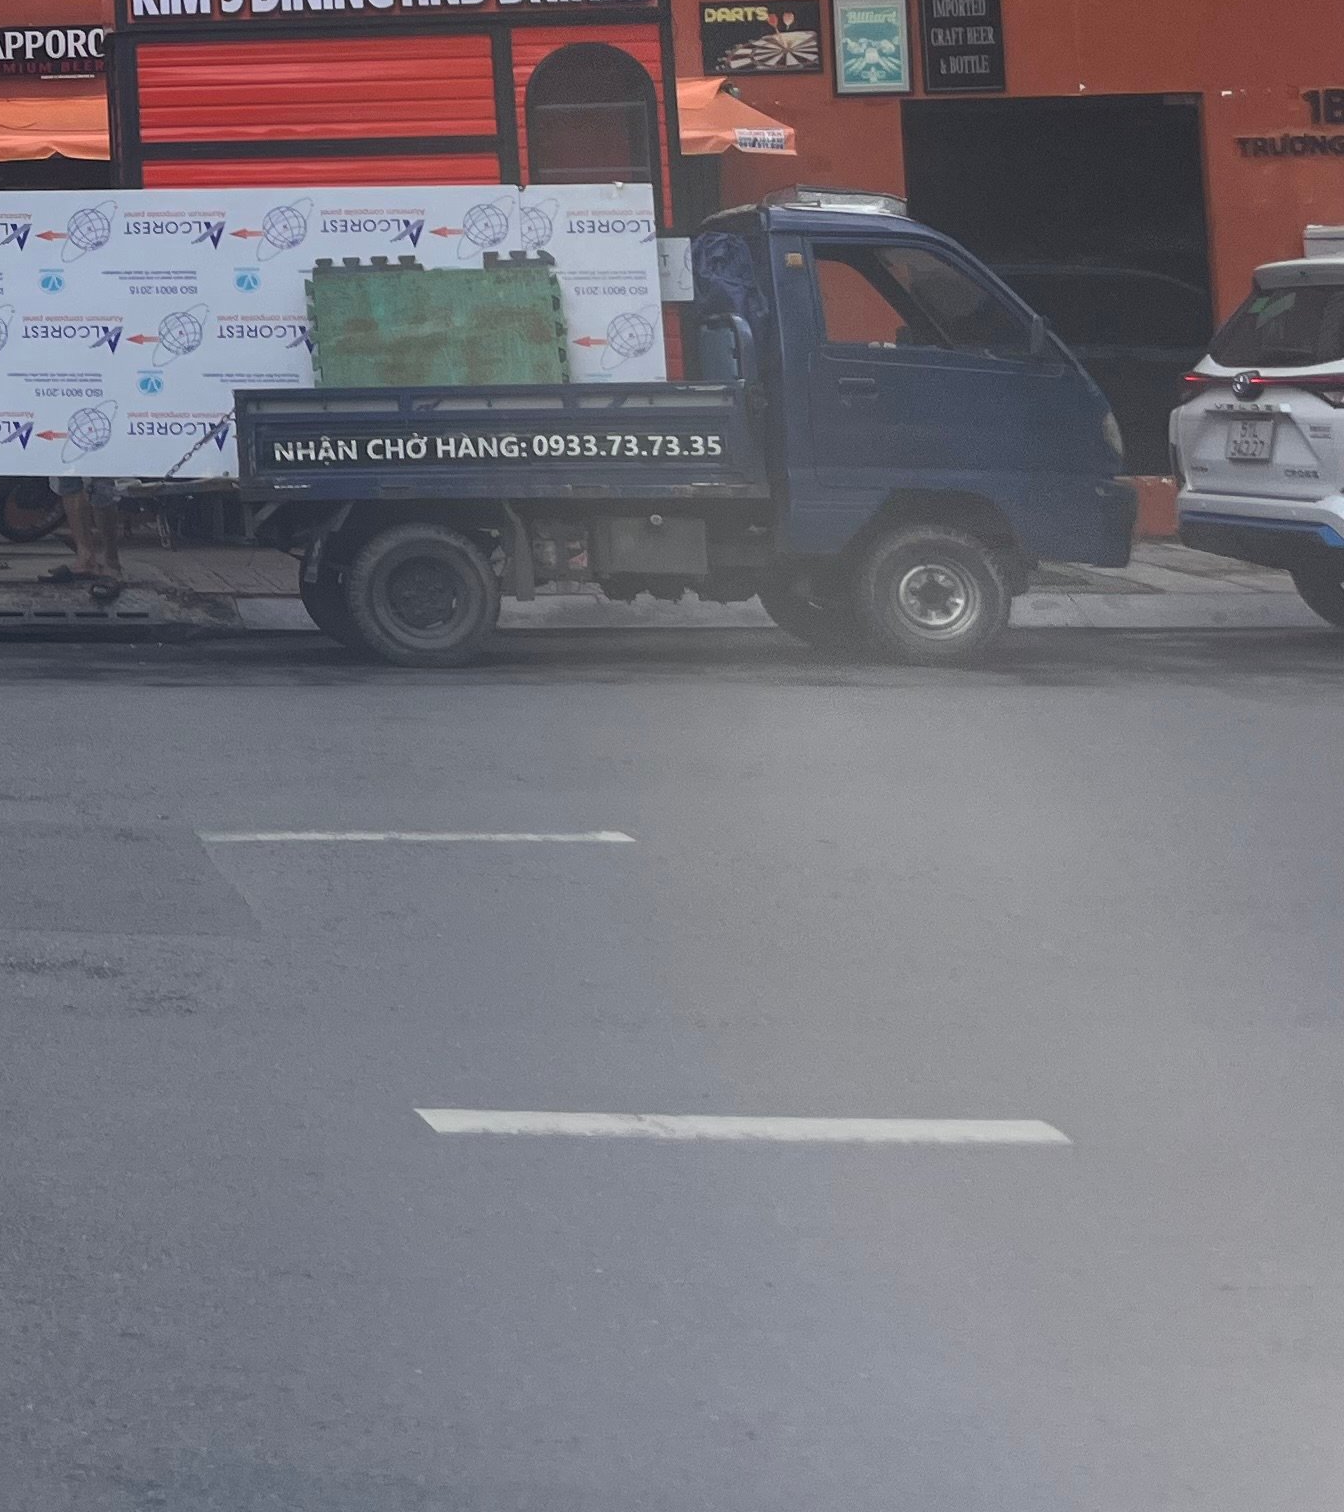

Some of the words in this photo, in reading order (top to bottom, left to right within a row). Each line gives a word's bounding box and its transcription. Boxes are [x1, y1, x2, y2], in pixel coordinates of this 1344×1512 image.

[704, 7, 768, 23] DARTS
[931, 27, 964, 46] CRAFT
[966, 26, 996, 44] BEER
[62, 61, 105, 72] BEER
[949, 55, 990, 74] BOTTLE
[124, 221, 226, 250] ALCOREST
[321, 219, 425, 248] ALCOREST
[566, 220, 655, 243] LCOREST
[22, 326, 123, 354] ALCOREST
[273, 435, 358, 465] NHẬN
[366, 432, 427, 460] CHỞ
[435, 432, 528, 459] HÀNG:
[532, 435, 722, 458] 0933.73.73.35
